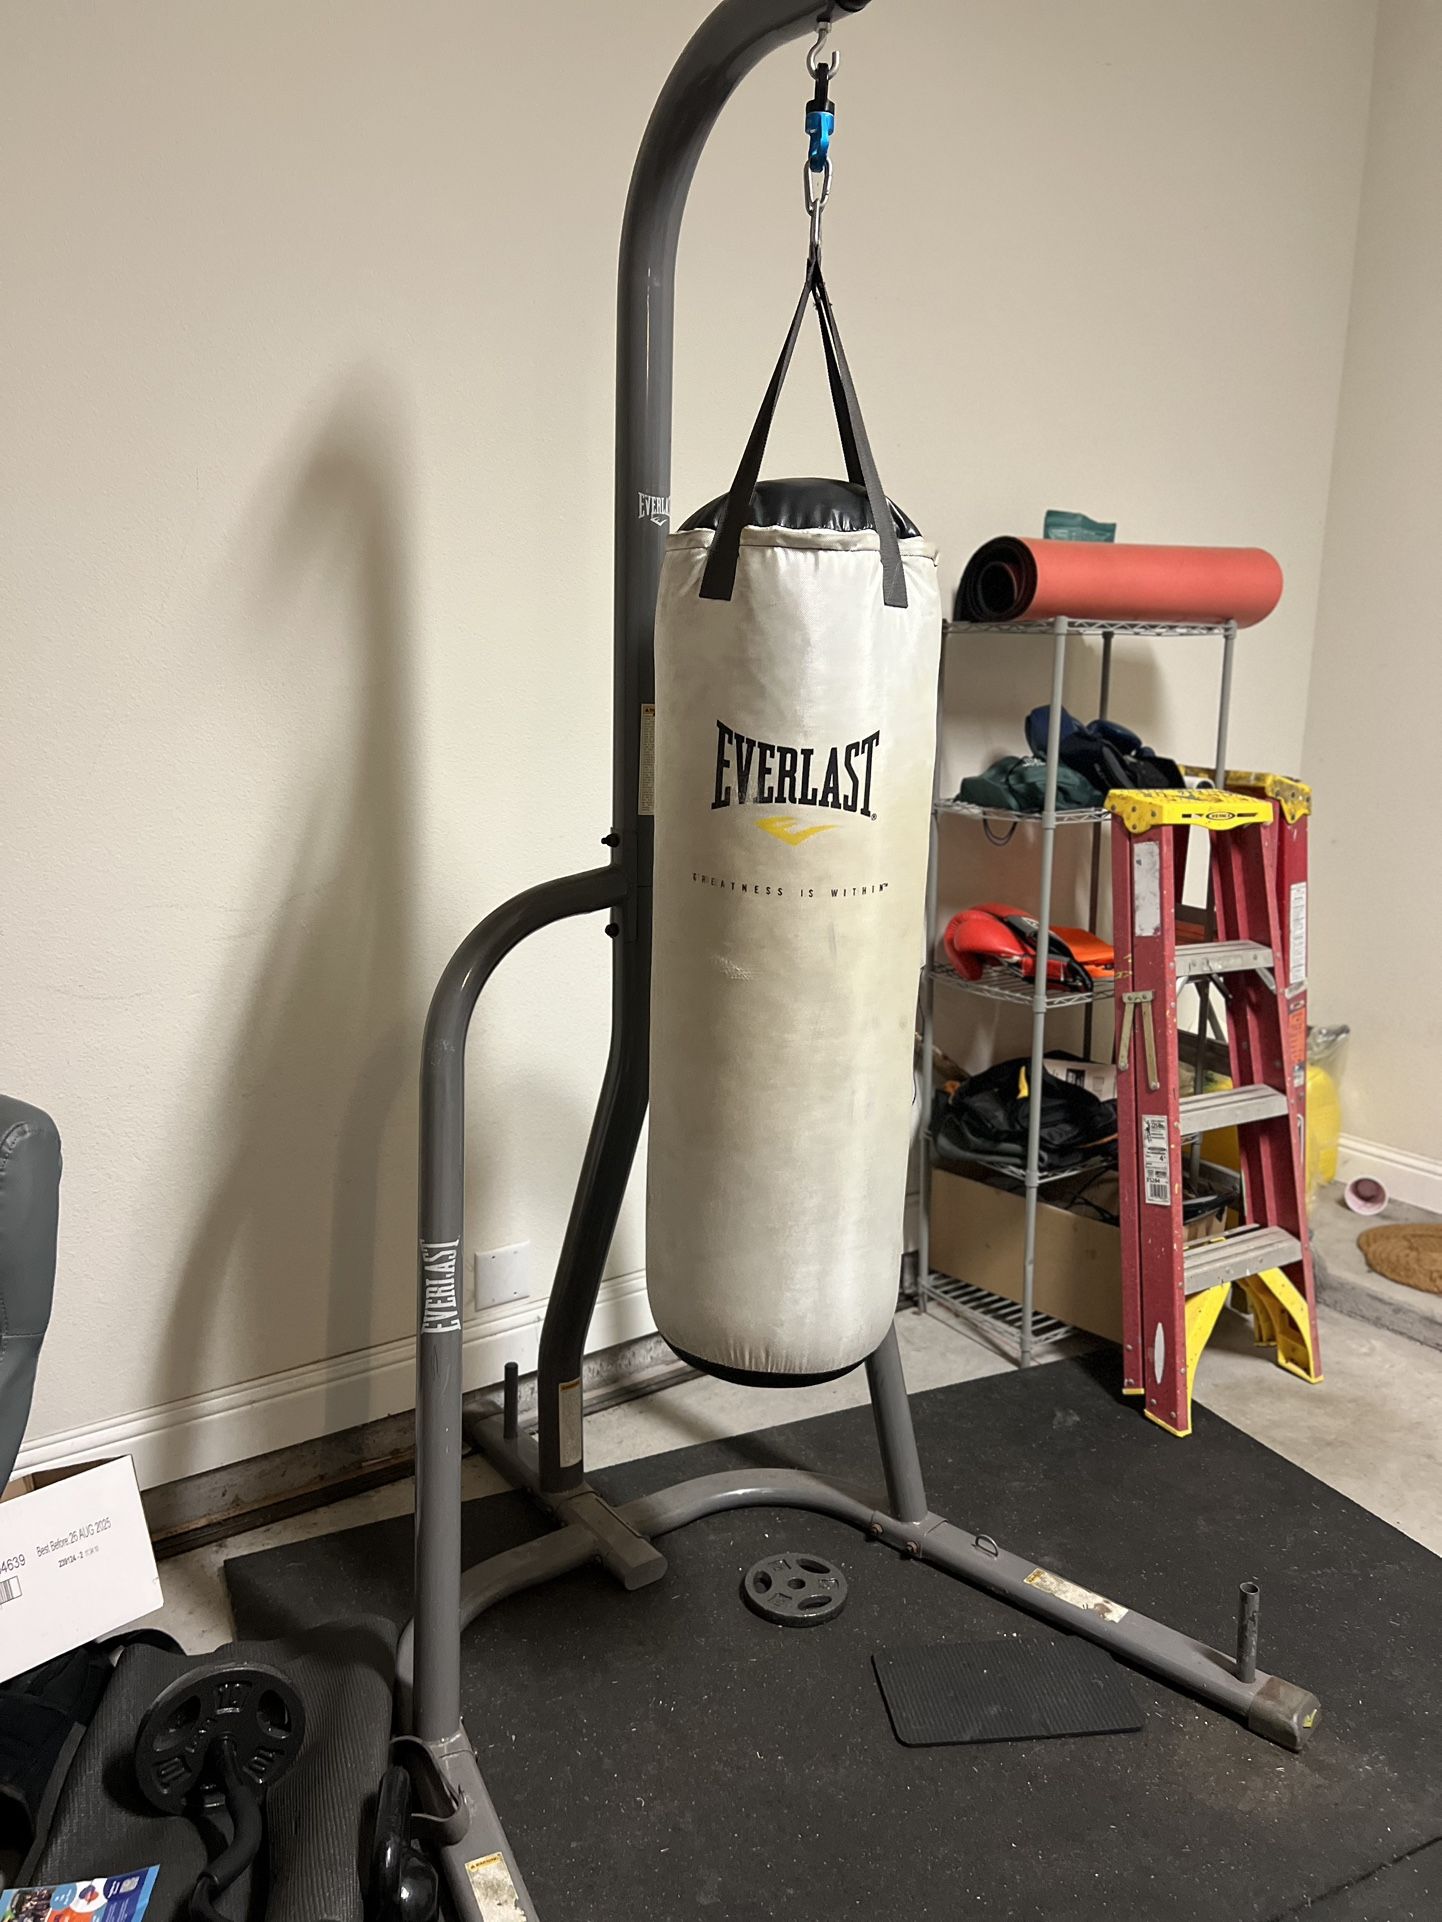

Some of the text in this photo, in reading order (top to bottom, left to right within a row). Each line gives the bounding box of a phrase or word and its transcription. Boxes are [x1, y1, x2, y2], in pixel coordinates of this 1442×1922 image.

[800, 888, 814, 898] IS
[419, 1235, 462, 1334] EVERLAST
[36, 1544, 50, 1557] Best
[79, 1523, 95, 1541] AUG
[95, 1517, 112, 1534] 2025
[0, 1553, 26, 1575] 4639
